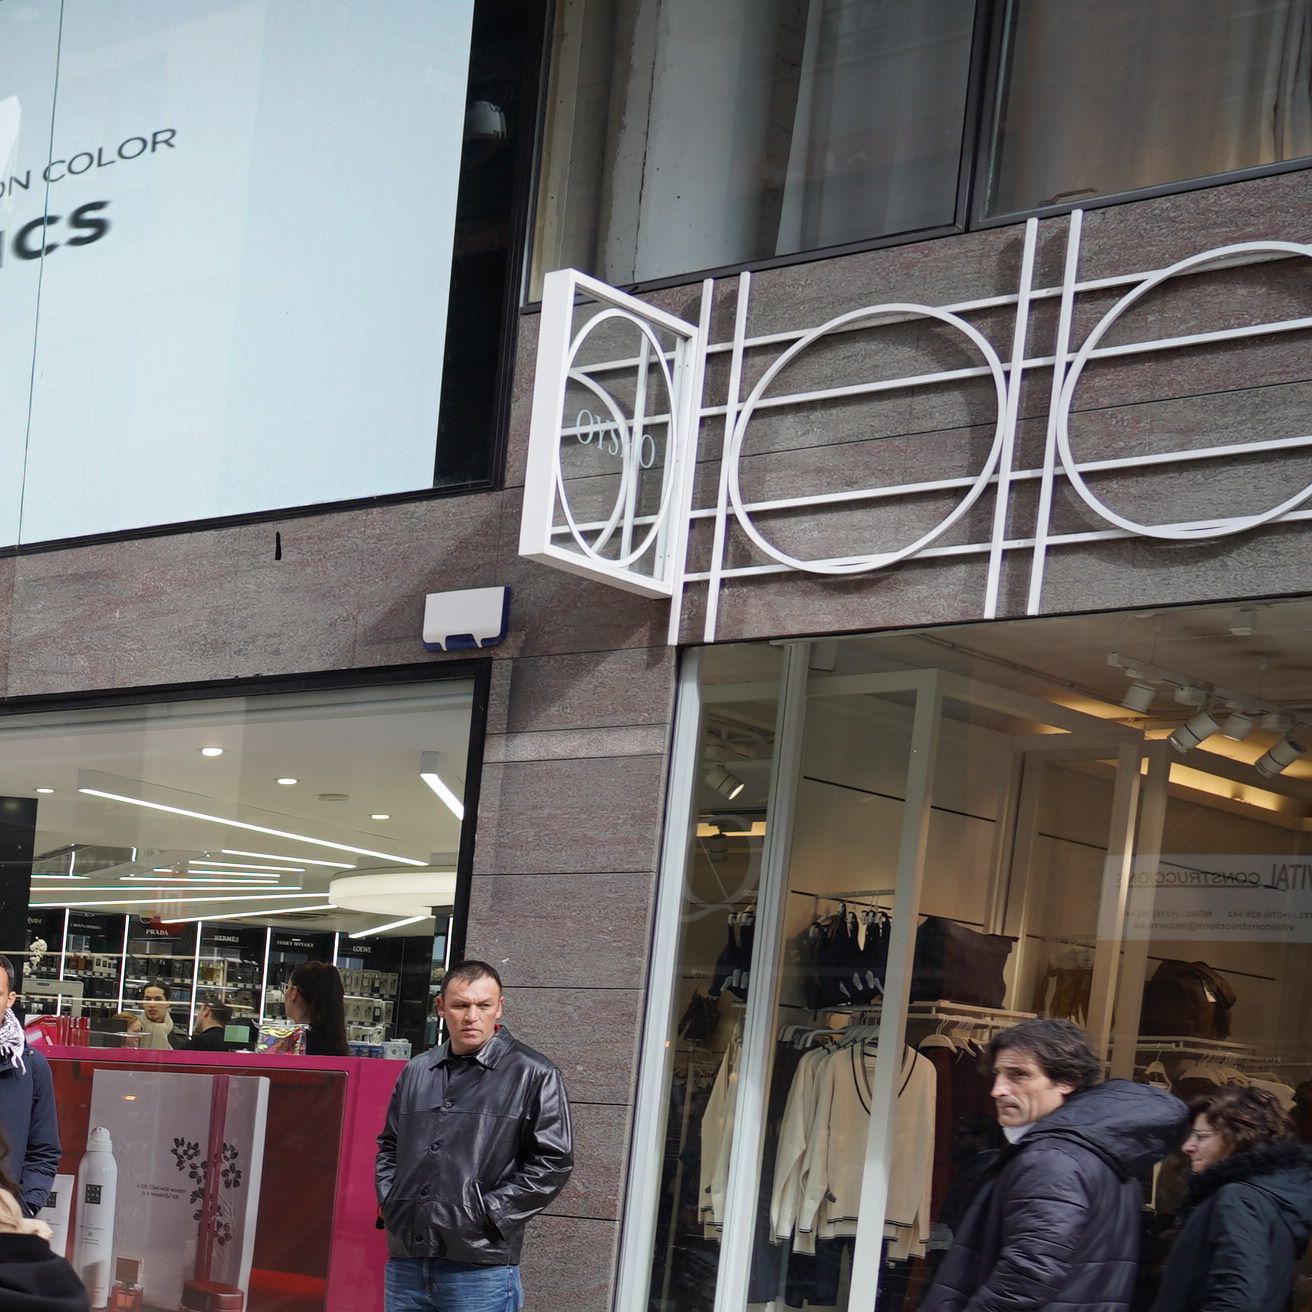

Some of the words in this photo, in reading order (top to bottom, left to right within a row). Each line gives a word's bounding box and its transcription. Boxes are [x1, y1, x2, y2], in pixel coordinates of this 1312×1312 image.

[42, 128, 178, 184] COLOR
[576, 409, 656, 469] OYSO
[145, 928, 169, 937] PRADA
[352, 945, 372, 953] LOEWE
